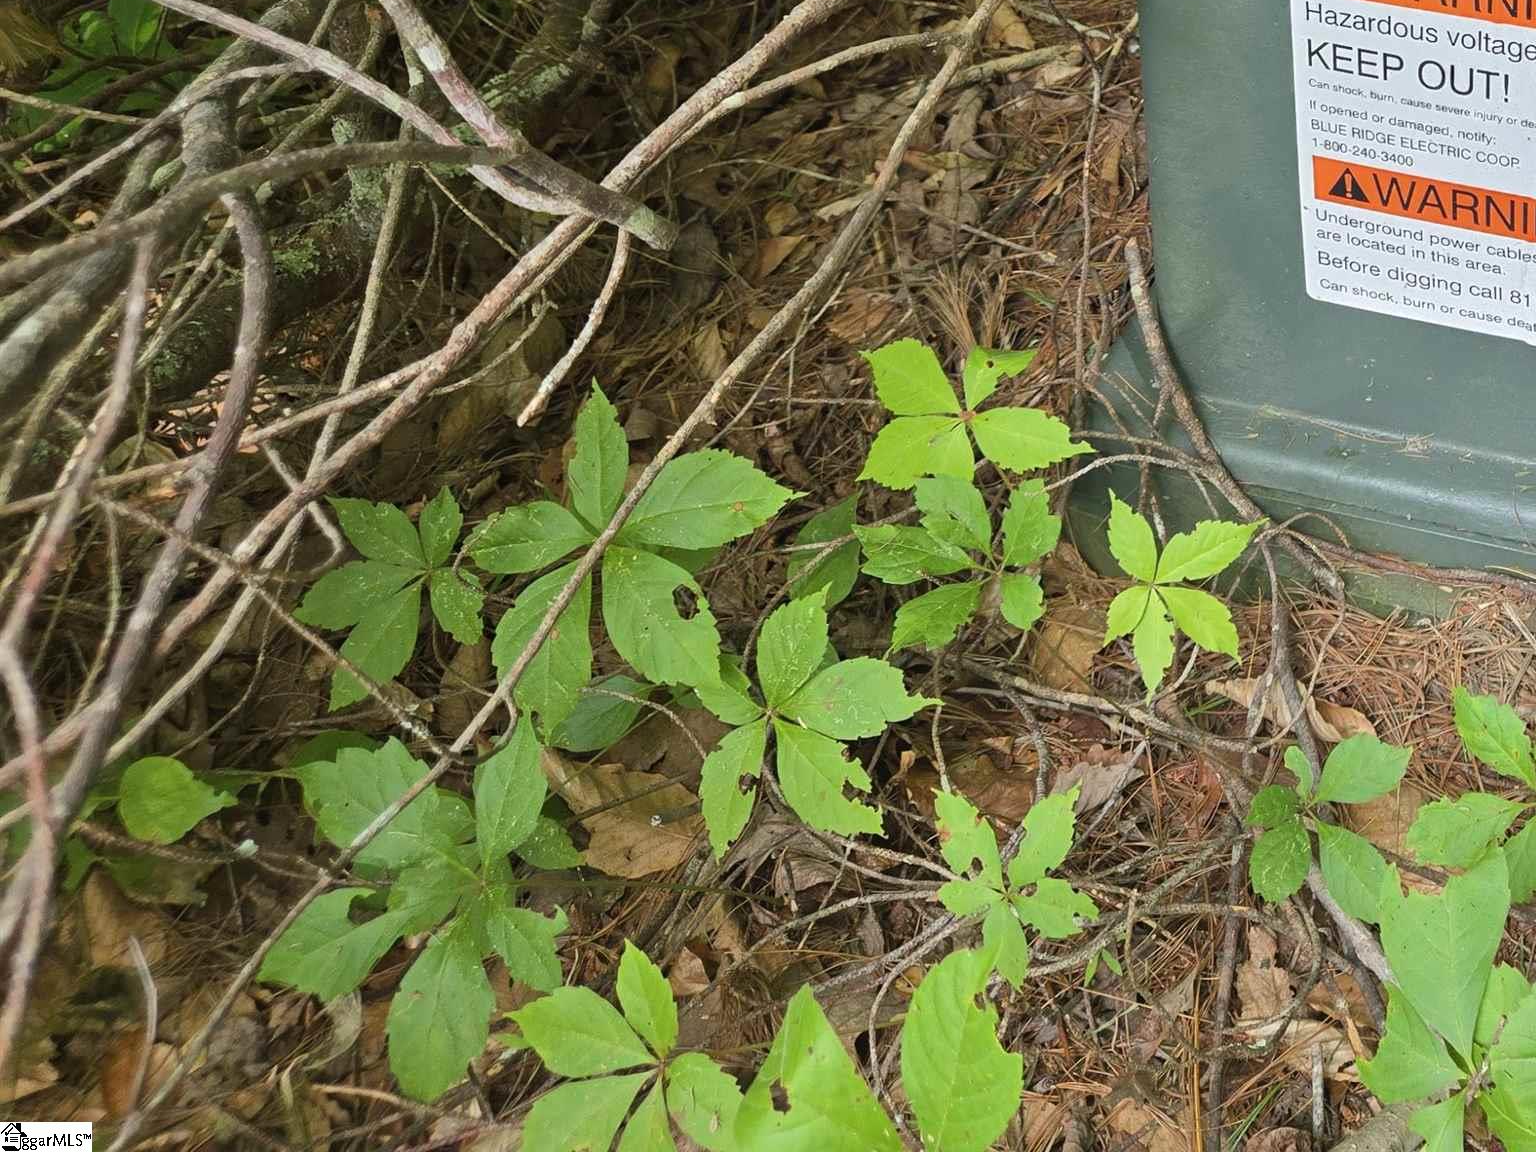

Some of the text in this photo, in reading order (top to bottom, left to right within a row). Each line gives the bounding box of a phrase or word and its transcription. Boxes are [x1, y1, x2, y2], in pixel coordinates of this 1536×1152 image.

[1305, 1, 1438, 43] Hazardous
[1307, 38, 1510, 102] KEEP OUT!
[1309, 78, 1329, 90] Can
[1401, 96, 1431, 110] cause
[1435, 103, 1470, 117] severe
[1506, 115, 1518, 125] or
[1310, 101, 1496, 145] If opened or damaged, notify:
[1311, 119, 1347, 136] BLUE
[1352, 126, 1396, 146] RIDGE
[1400, 136, 1472, 160] ELECTRIC
[1312, 138, 1413, 167] 1-800-240-3400
[1316, 209, 1424, 241] Underground
[1429, 233, 1481, 255] power
[1316, 229, 1506, 276] are located in this area.
[1318, 251, 1381, 277] Before
[1387, 265, 1462, 296] digging
[1469, 282, 1502, 301] call
[1320, 277, 1348, 293] Can
[1352, 285, 1398, 306] shock,
[1403, 295, 1435, 312] burn
[1440, 303, 1455, 314] or
[1459, 307, 1503, 325] cause
